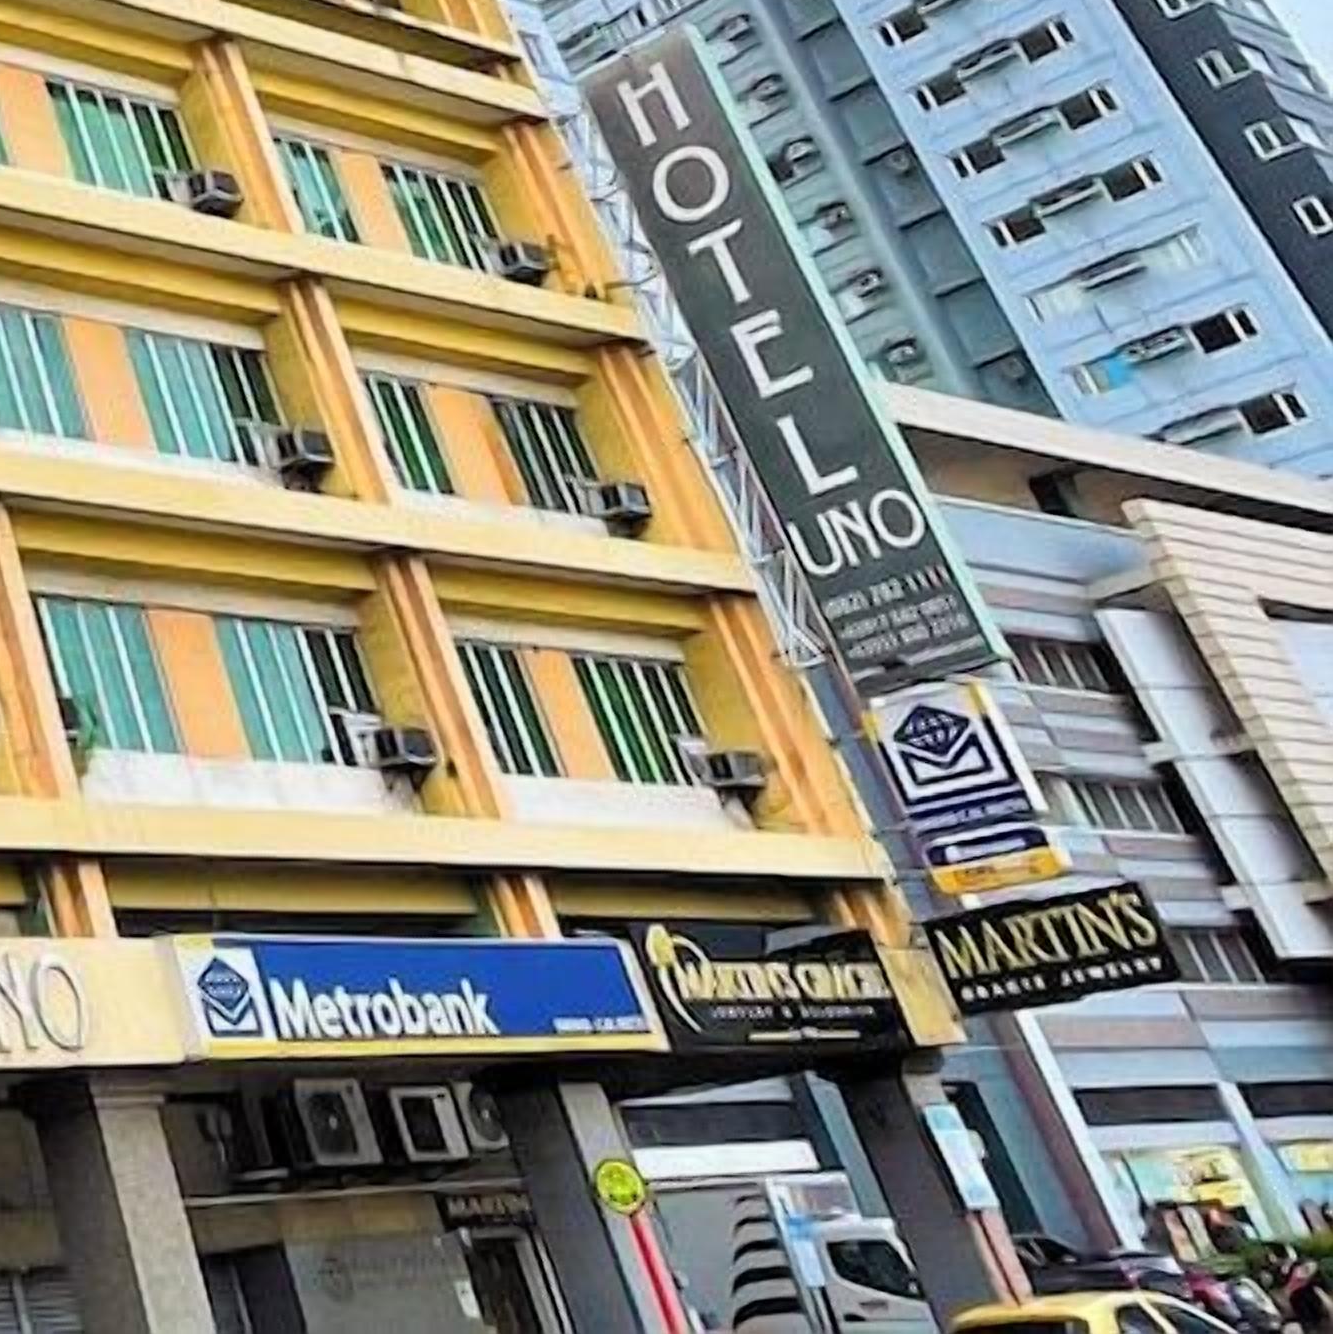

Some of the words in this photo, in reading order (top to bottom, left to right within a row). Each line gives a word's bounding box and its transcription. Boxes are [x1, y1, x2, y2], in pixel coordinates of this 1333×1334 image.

[616, 60, 858, 497] HOTEL
[789, 488, 927, 576] UNO
[269, 977, 501, 1040] Metrobank
